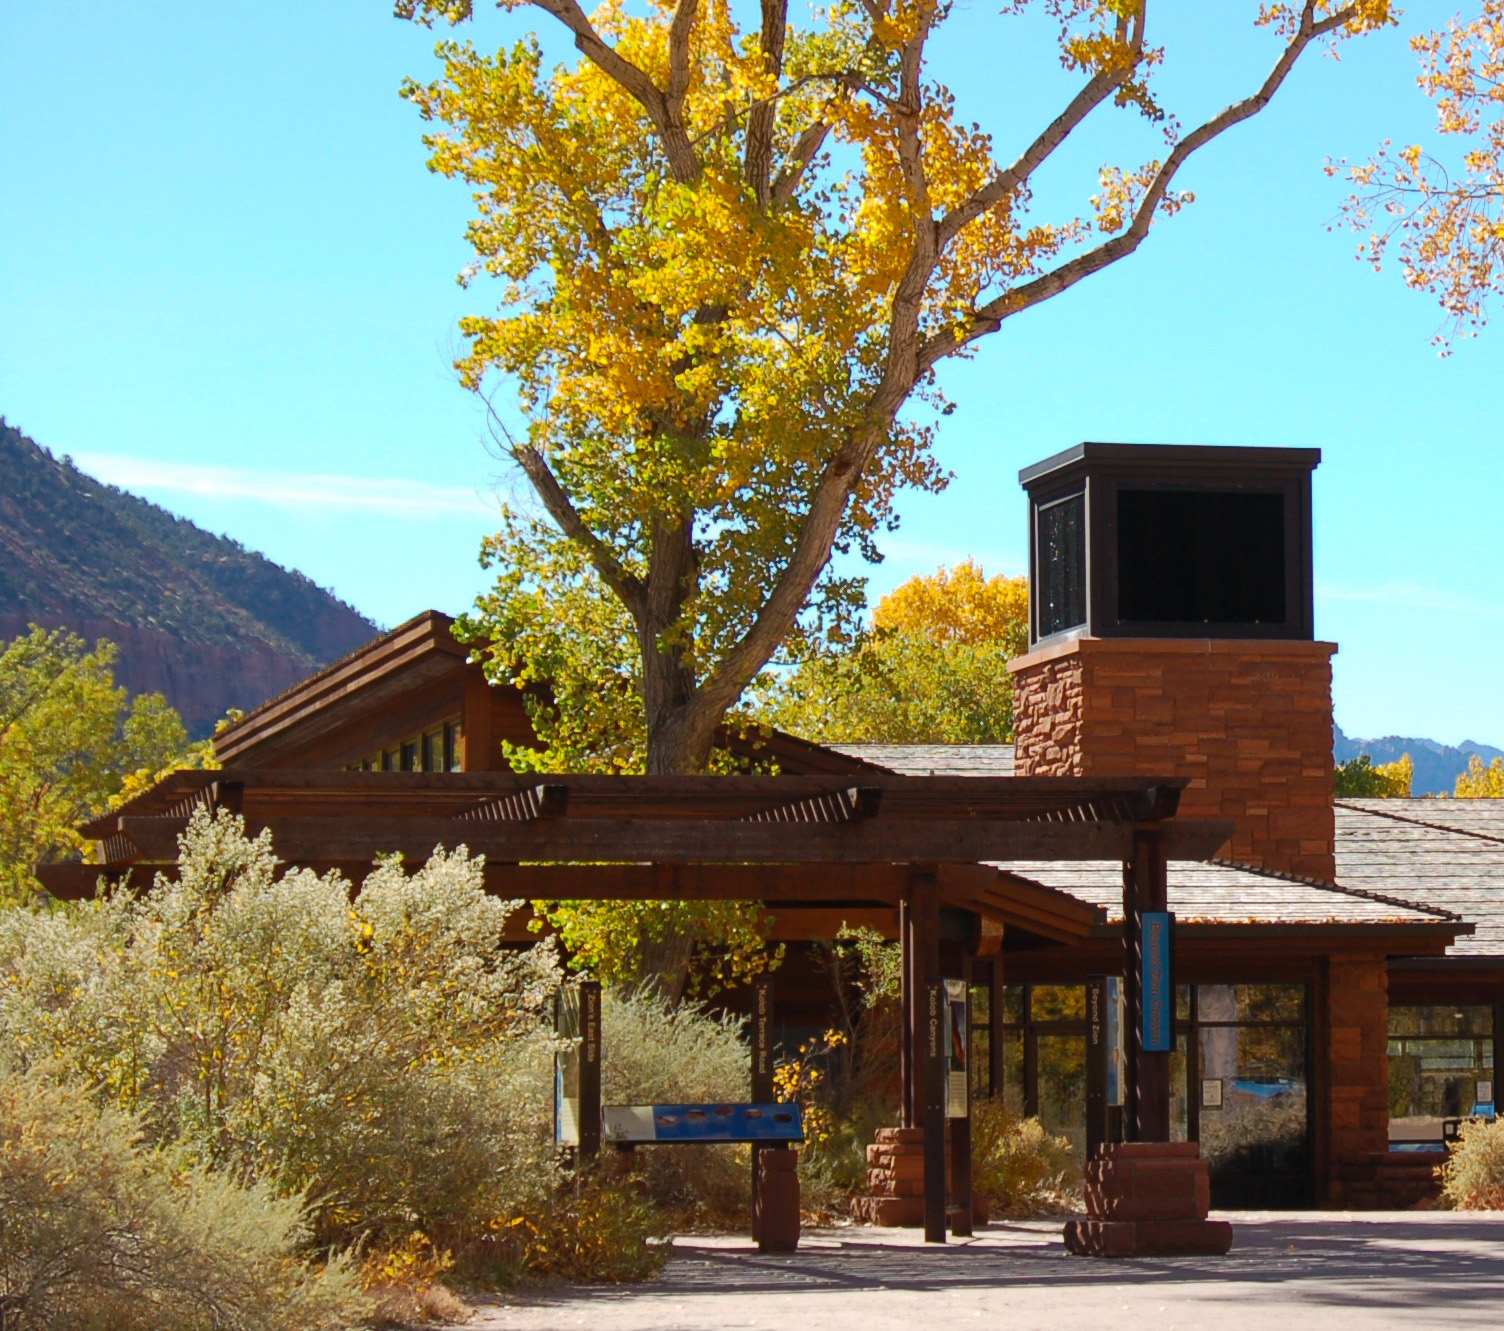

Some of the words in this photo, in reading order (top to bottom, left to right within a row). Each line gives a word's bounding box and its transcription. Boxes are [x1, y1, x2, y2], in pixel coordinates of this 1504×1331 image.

[759, 989, 767, 1014] Kolob
[929, 990, 937, 1016] Kolob
[1090, 988, 1100, 1022] Beyond
[588, 1022, 596, 1041] East
[759, 1017, 767, 1049] Terrace
[928, 1018, 938, 1057] Canyons
[1092, 1024, 1100, 1045] Zion
[588, 1043, 596, 1063] Side
[759, 1051, 767, 1074] Road
